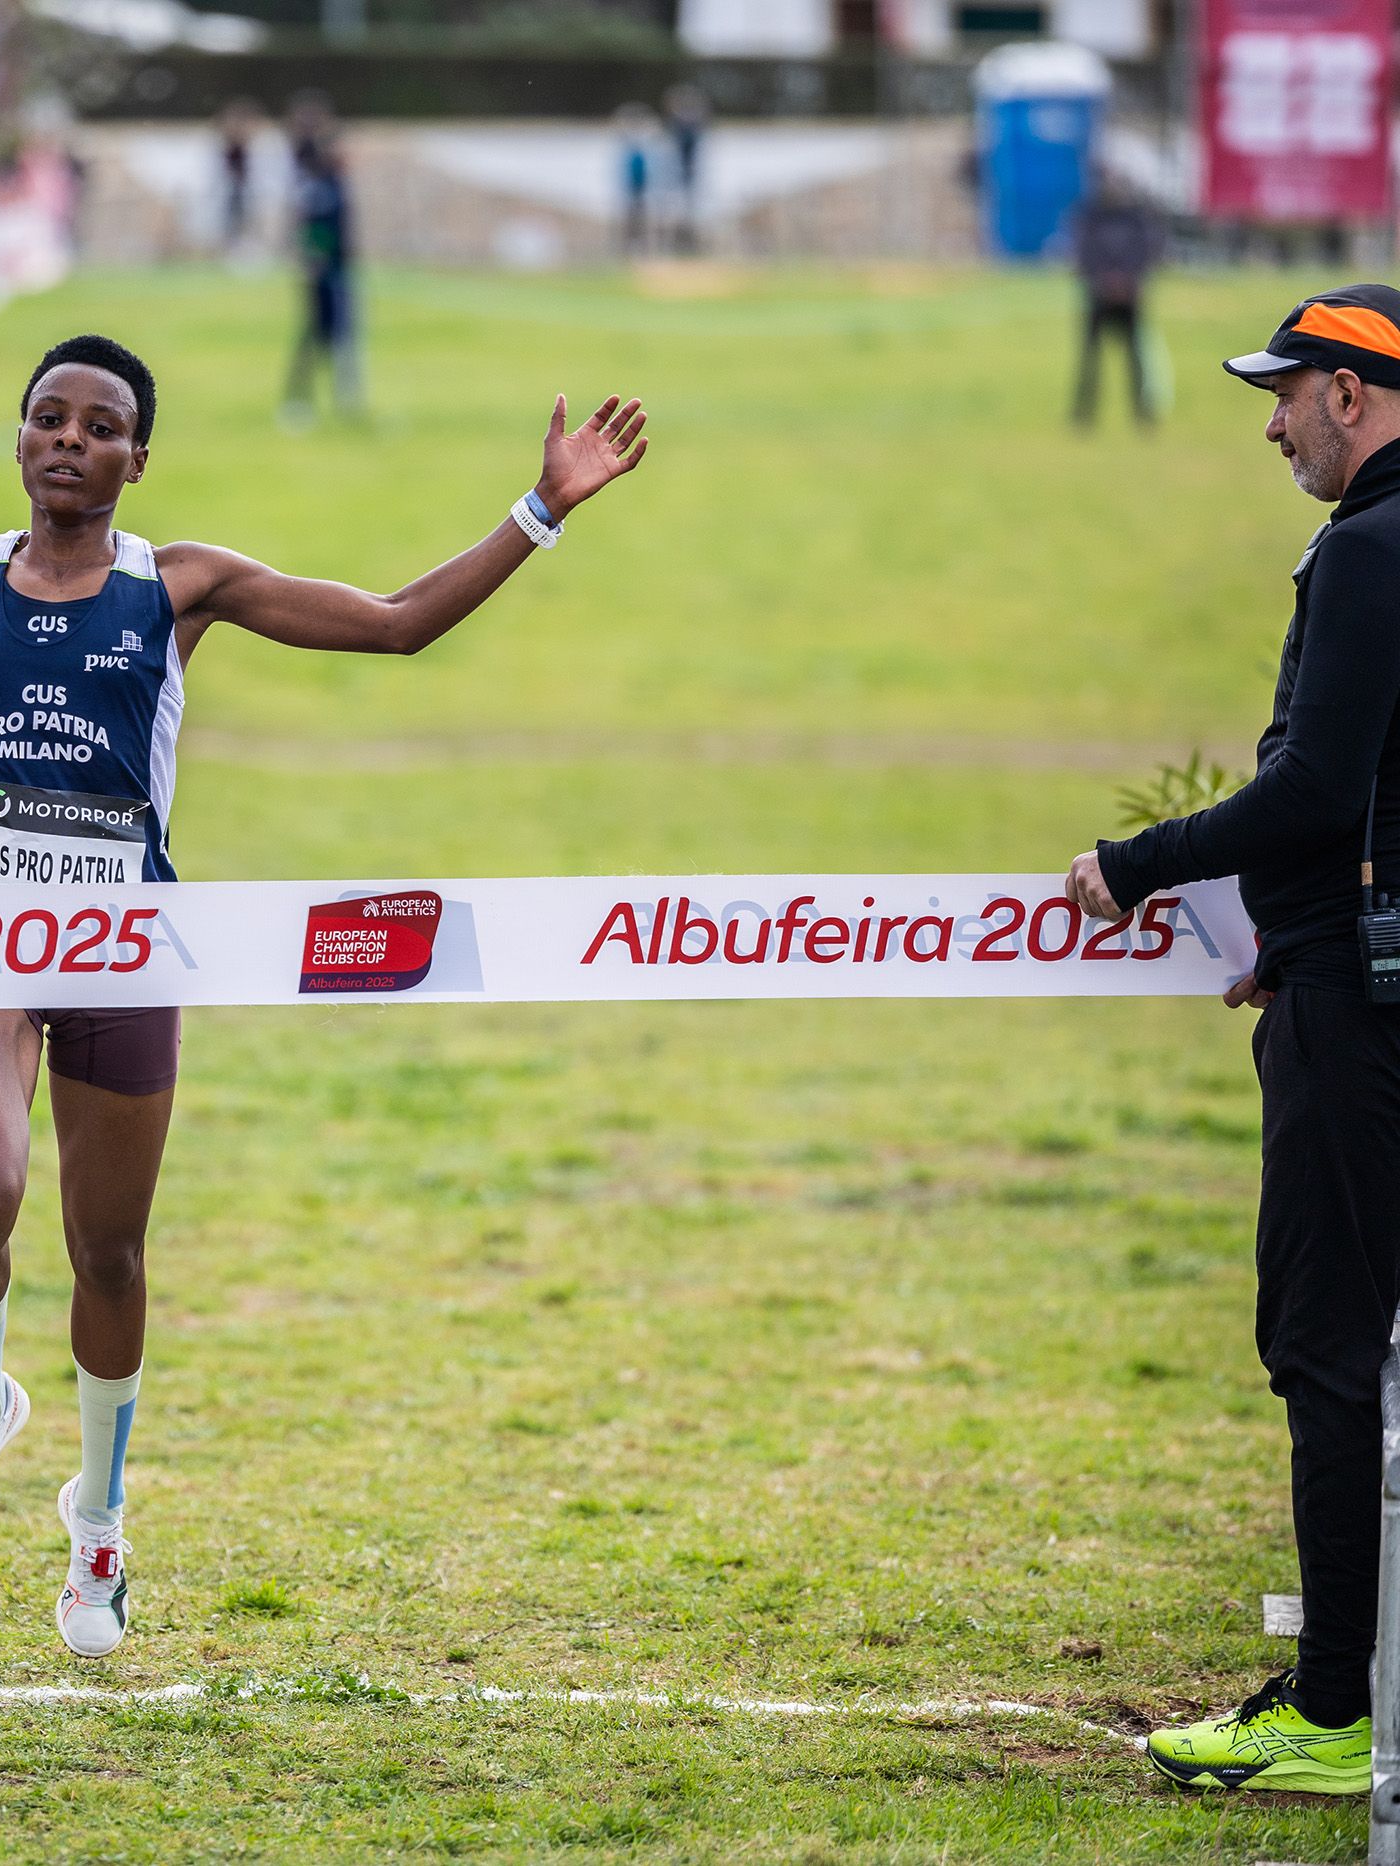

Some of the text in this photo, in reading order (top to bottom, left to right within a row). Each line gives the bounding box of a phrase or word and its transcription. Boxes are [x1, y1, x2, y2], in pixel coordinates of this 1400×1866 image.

[28, 615, 68, 633] CUS
[84, 654, 130, 672] pwc
[21, 685, 67, 706] CUS
[32, 710, 111, 751] PATRIA
[18, 799, 134, 827] MOTORPOR
[16, 848, 54, 884] PRO
[59, 854, 126, 884] PATRIA
[381, 900, 436, 909] EUROPEAN
[381, 908, 436, 917] ATHLETICS
[315, 931, 388, 942] EUROPEAN
[581, 896, 1181, 965] Albufeira 2025
[314, 943, 387, 953] CHAMPION
[312, 953, 386, 965] CLUBS CUP
[308, 977, 395, 989] Albufeira 2025
